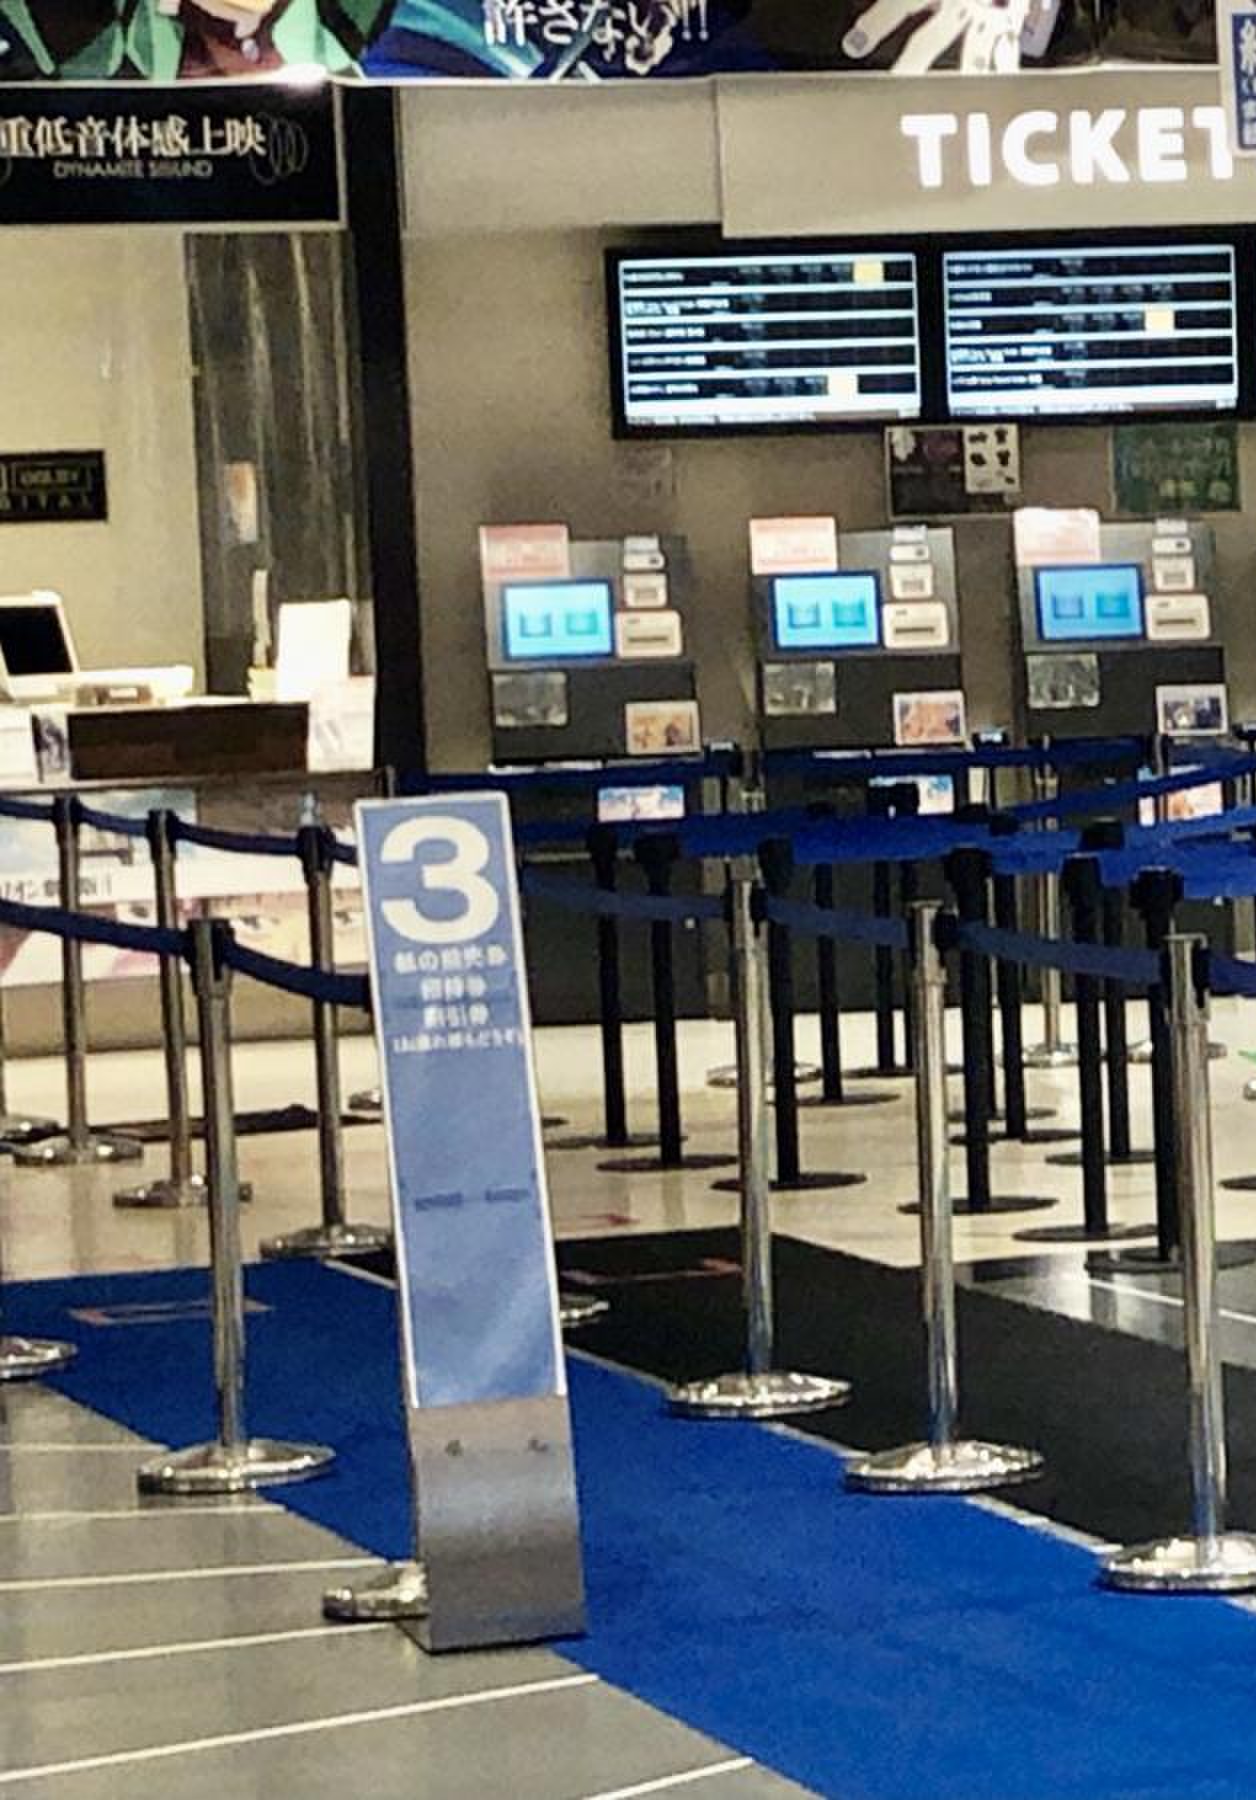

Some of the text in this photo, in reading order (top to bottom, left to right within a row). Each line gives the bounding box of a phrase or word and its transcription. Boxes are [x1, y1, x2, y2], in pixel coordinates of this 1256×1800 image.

[0, 114, 267, 158] 重低音体感上映
[381, 816, 499, 944] 3
